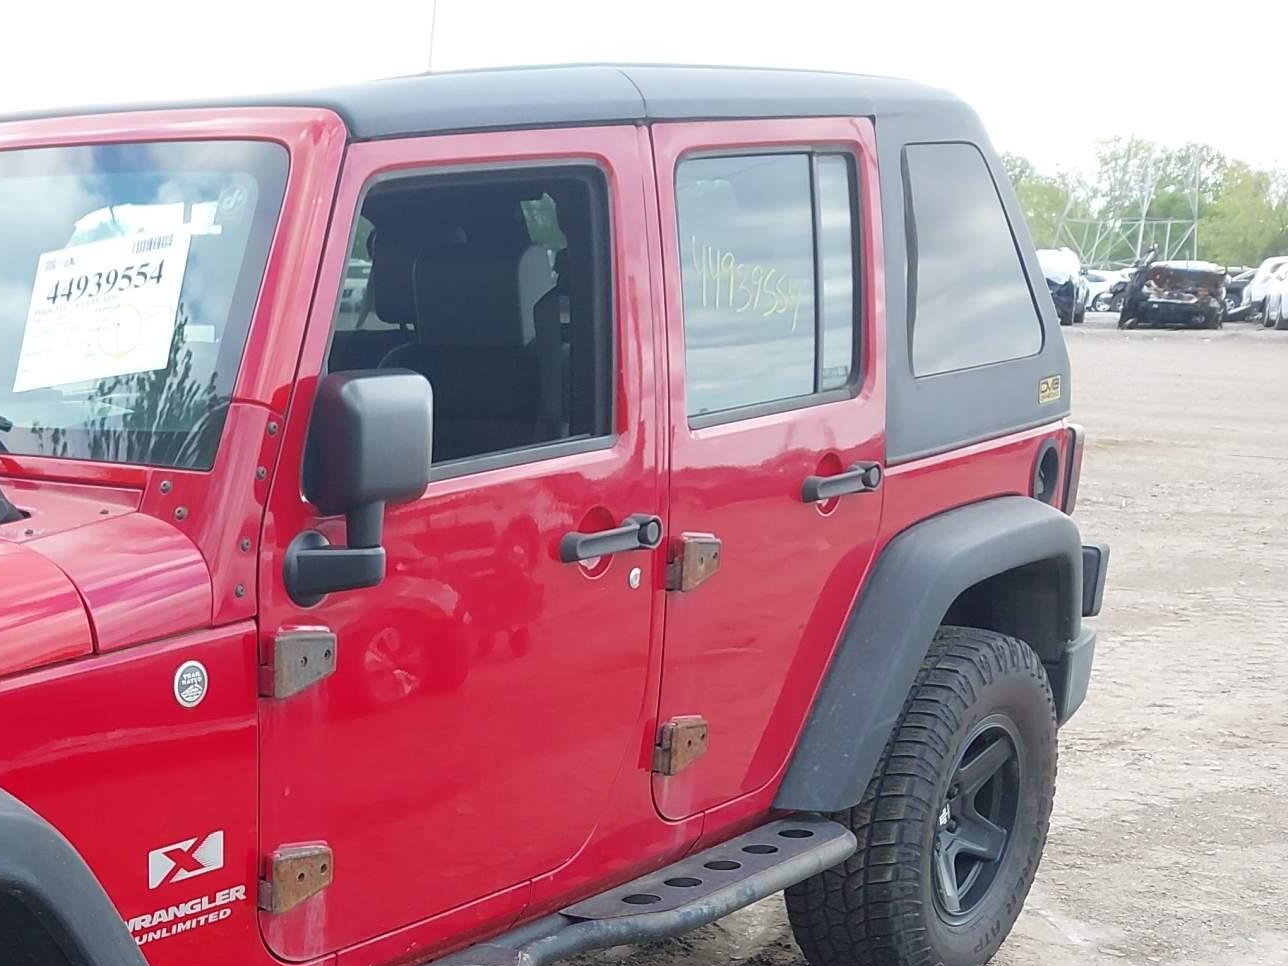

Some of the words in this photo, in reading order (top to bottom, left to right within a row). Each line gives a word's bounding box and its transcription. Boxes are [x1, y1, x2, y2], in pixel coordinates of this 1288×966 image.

[46, 258, 166, 304] 44939554
[688, 232, 802, 333] 44939554
[134, 908, 233, 946] UNLIMITED
